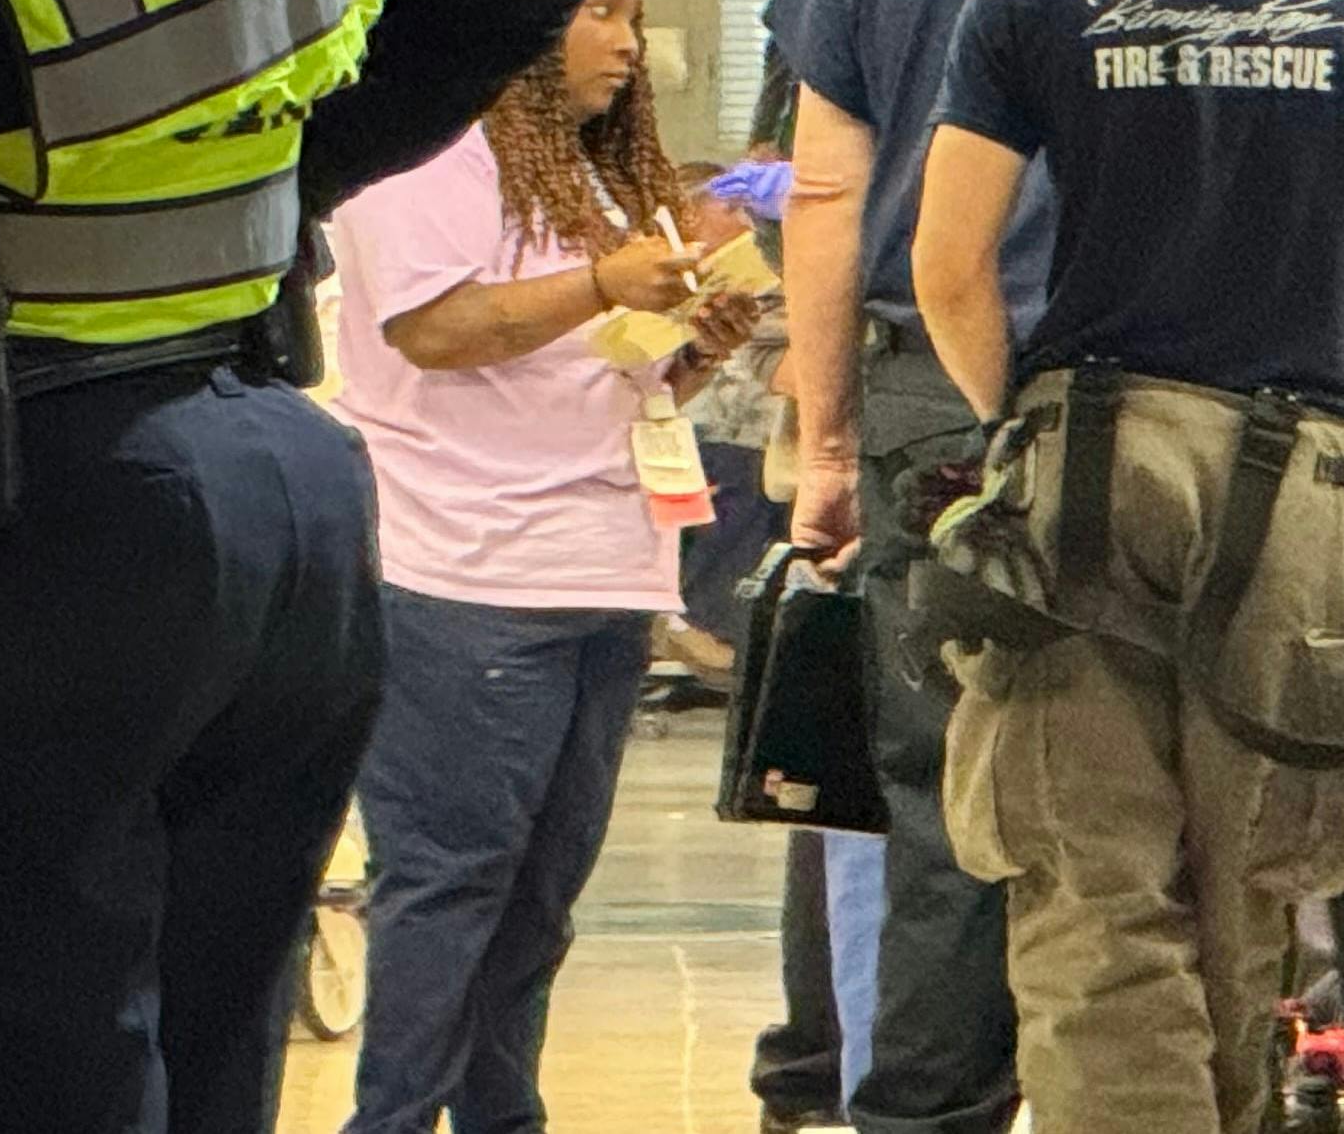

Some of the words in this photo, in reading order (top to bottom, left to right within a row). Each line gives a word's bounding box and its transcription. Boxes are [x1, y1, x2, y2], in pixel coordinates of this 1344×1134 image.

[1094, 45, 1168, 89] FIRE
[1176, 43, 1202, 86] &
[1209, 45, 1336, 91] RESCUE
